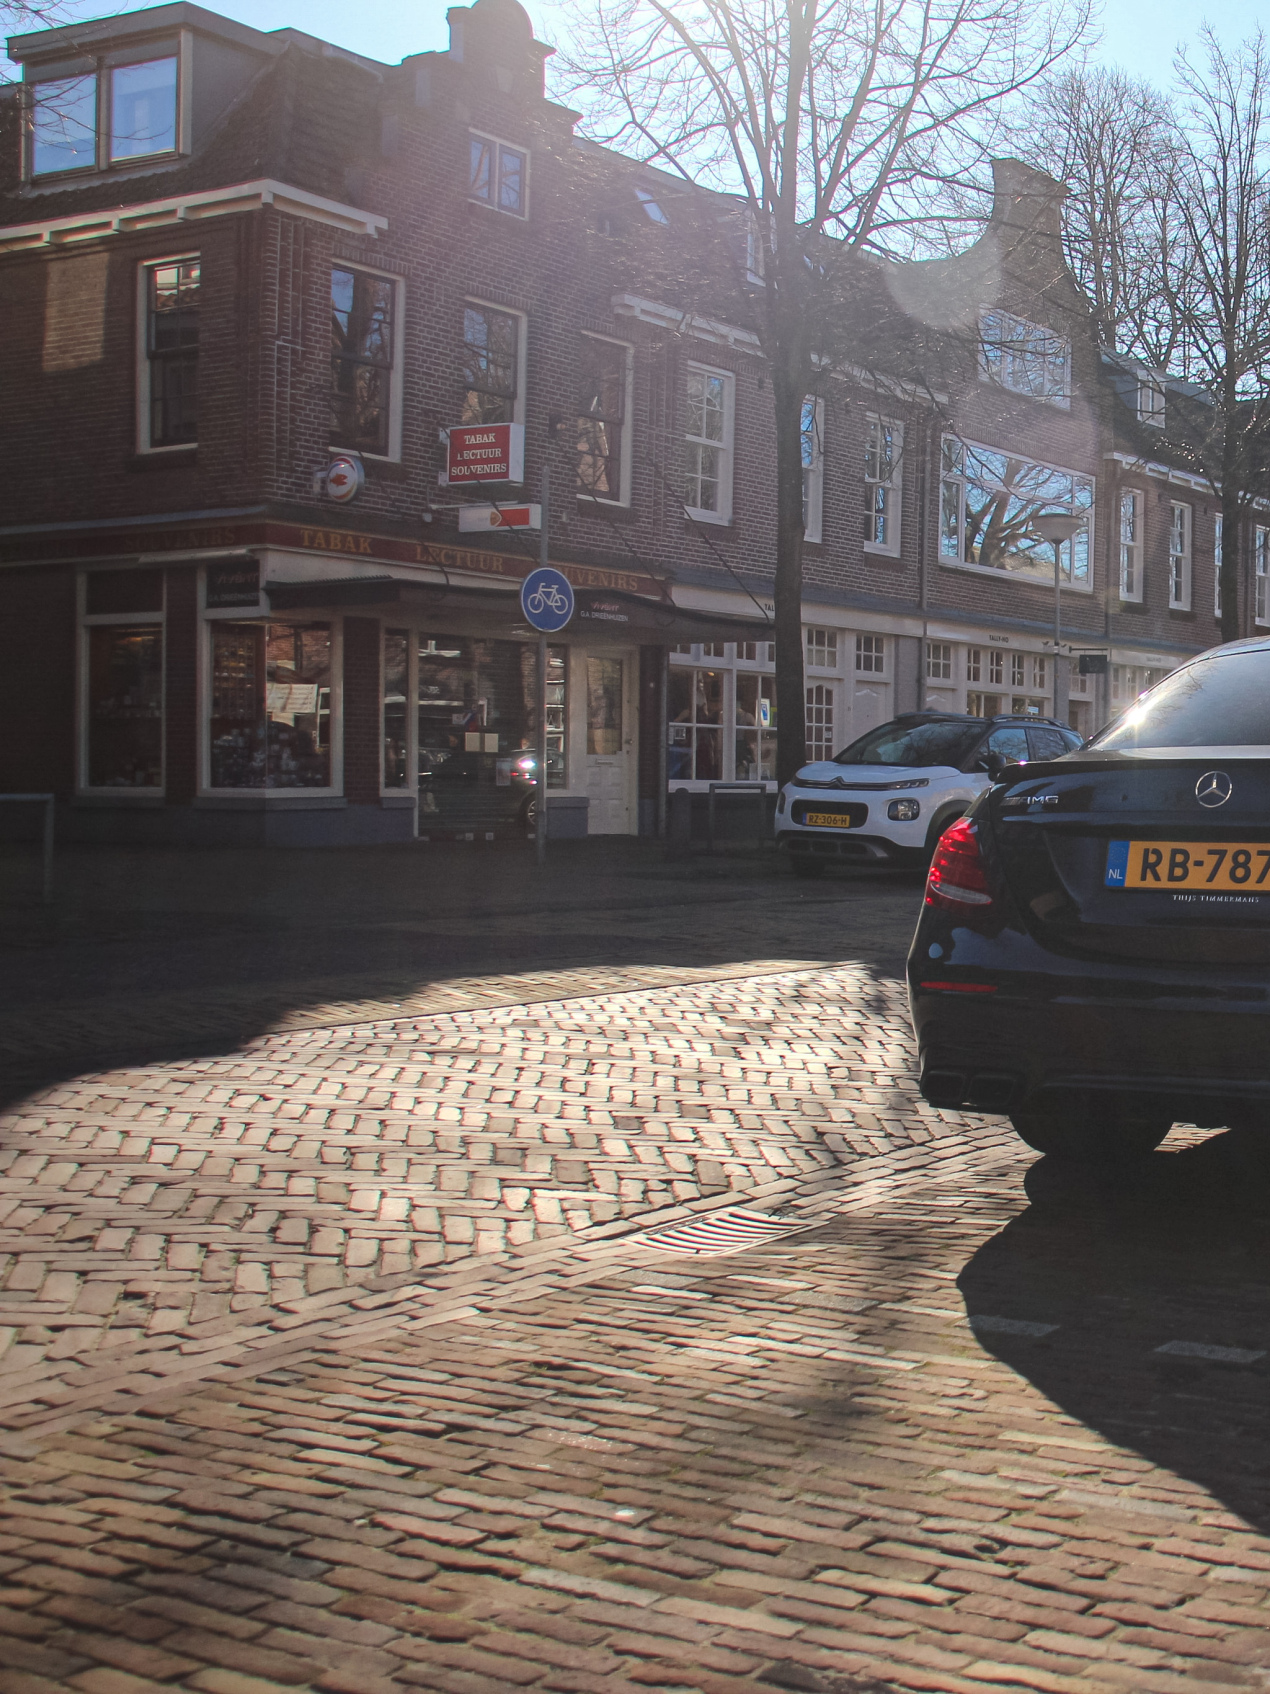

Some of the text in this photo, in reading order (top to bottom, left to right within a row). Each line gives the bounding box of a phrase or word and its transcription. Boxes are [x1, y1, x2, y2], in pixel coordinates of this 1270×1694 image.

[464, 433, 496, 444] TABAK
[457, 448, 502, 460] LECTUUR
[451, 463, 507, 476] SOUVENIRS
[301, 529, 372, 554] TABAK
[416, 544, 503, 572] LECTUUR
[808, 814, 847, 826] RZ-306-H
[1108, 868, 1123, 880] NL
[1172, 894, 1260, 903] THIJS TIMMERMANS
